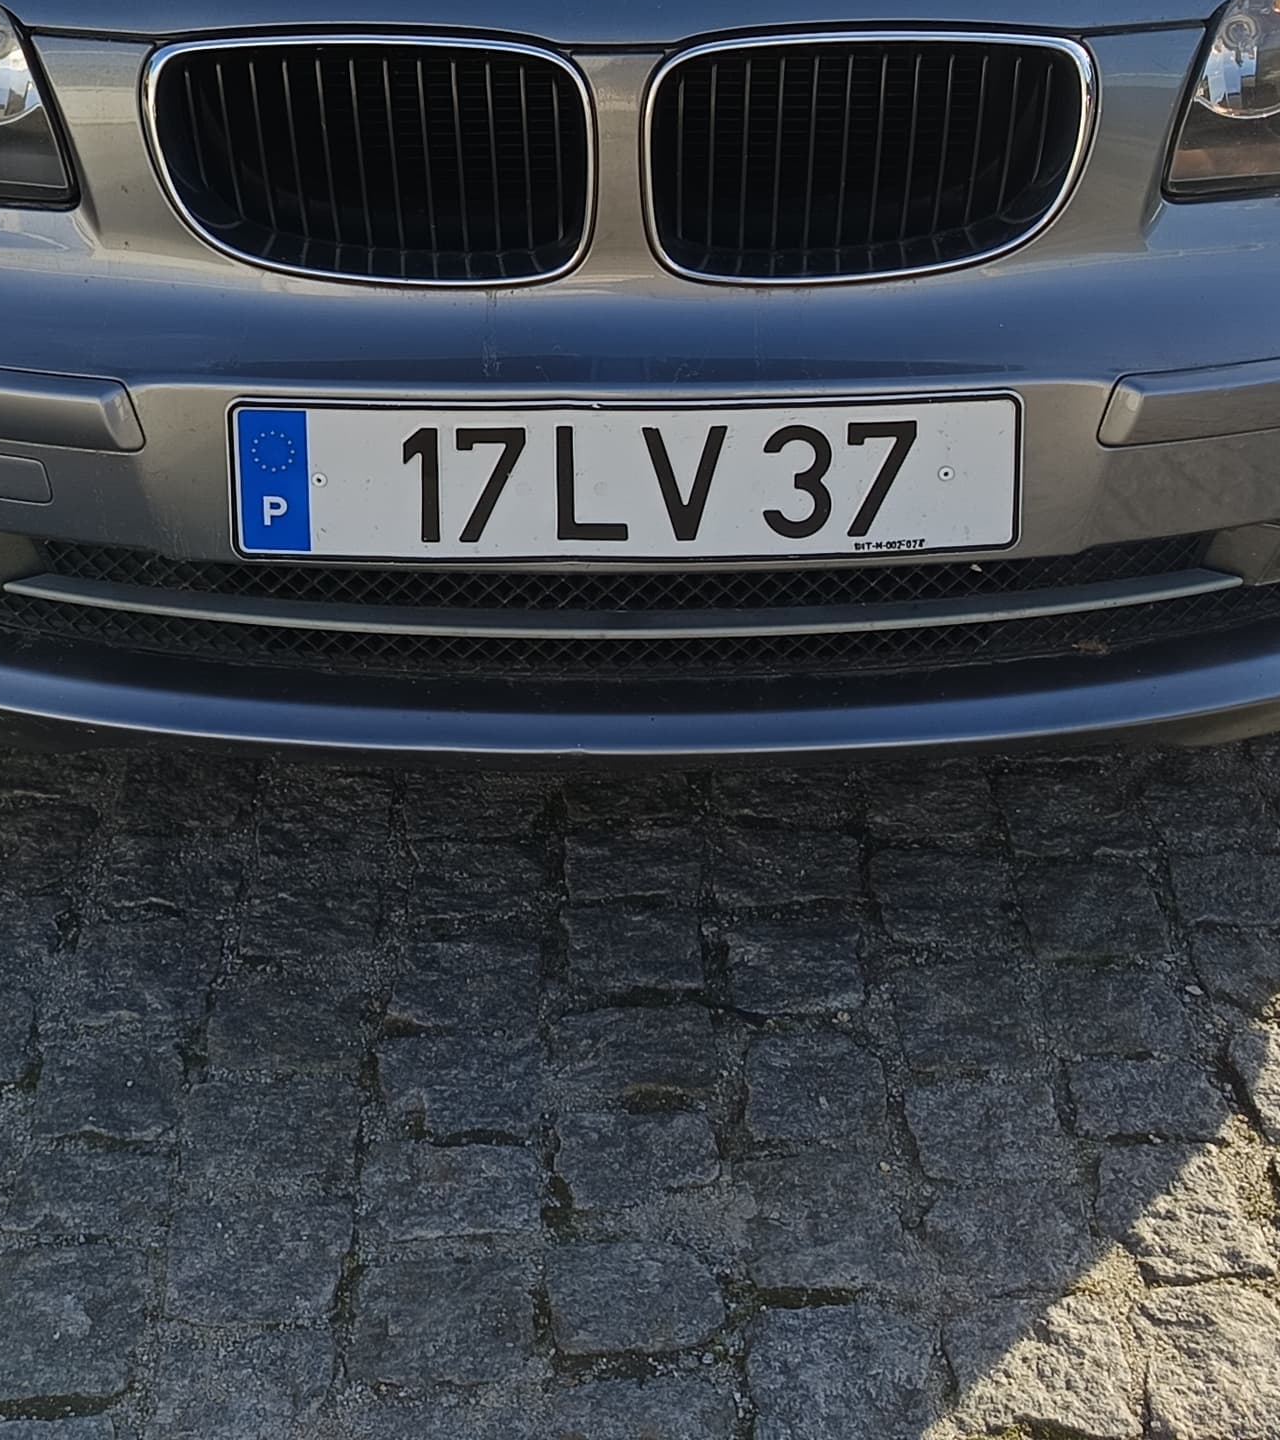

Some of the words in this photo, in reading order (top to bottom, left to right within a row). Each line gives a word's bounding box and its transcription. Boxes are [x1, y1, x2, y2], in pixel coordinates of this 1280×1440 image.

[262, 496, 288, 526] P
[402, 427, 526, 543] 17
[762, 420, 917, 539] 37
